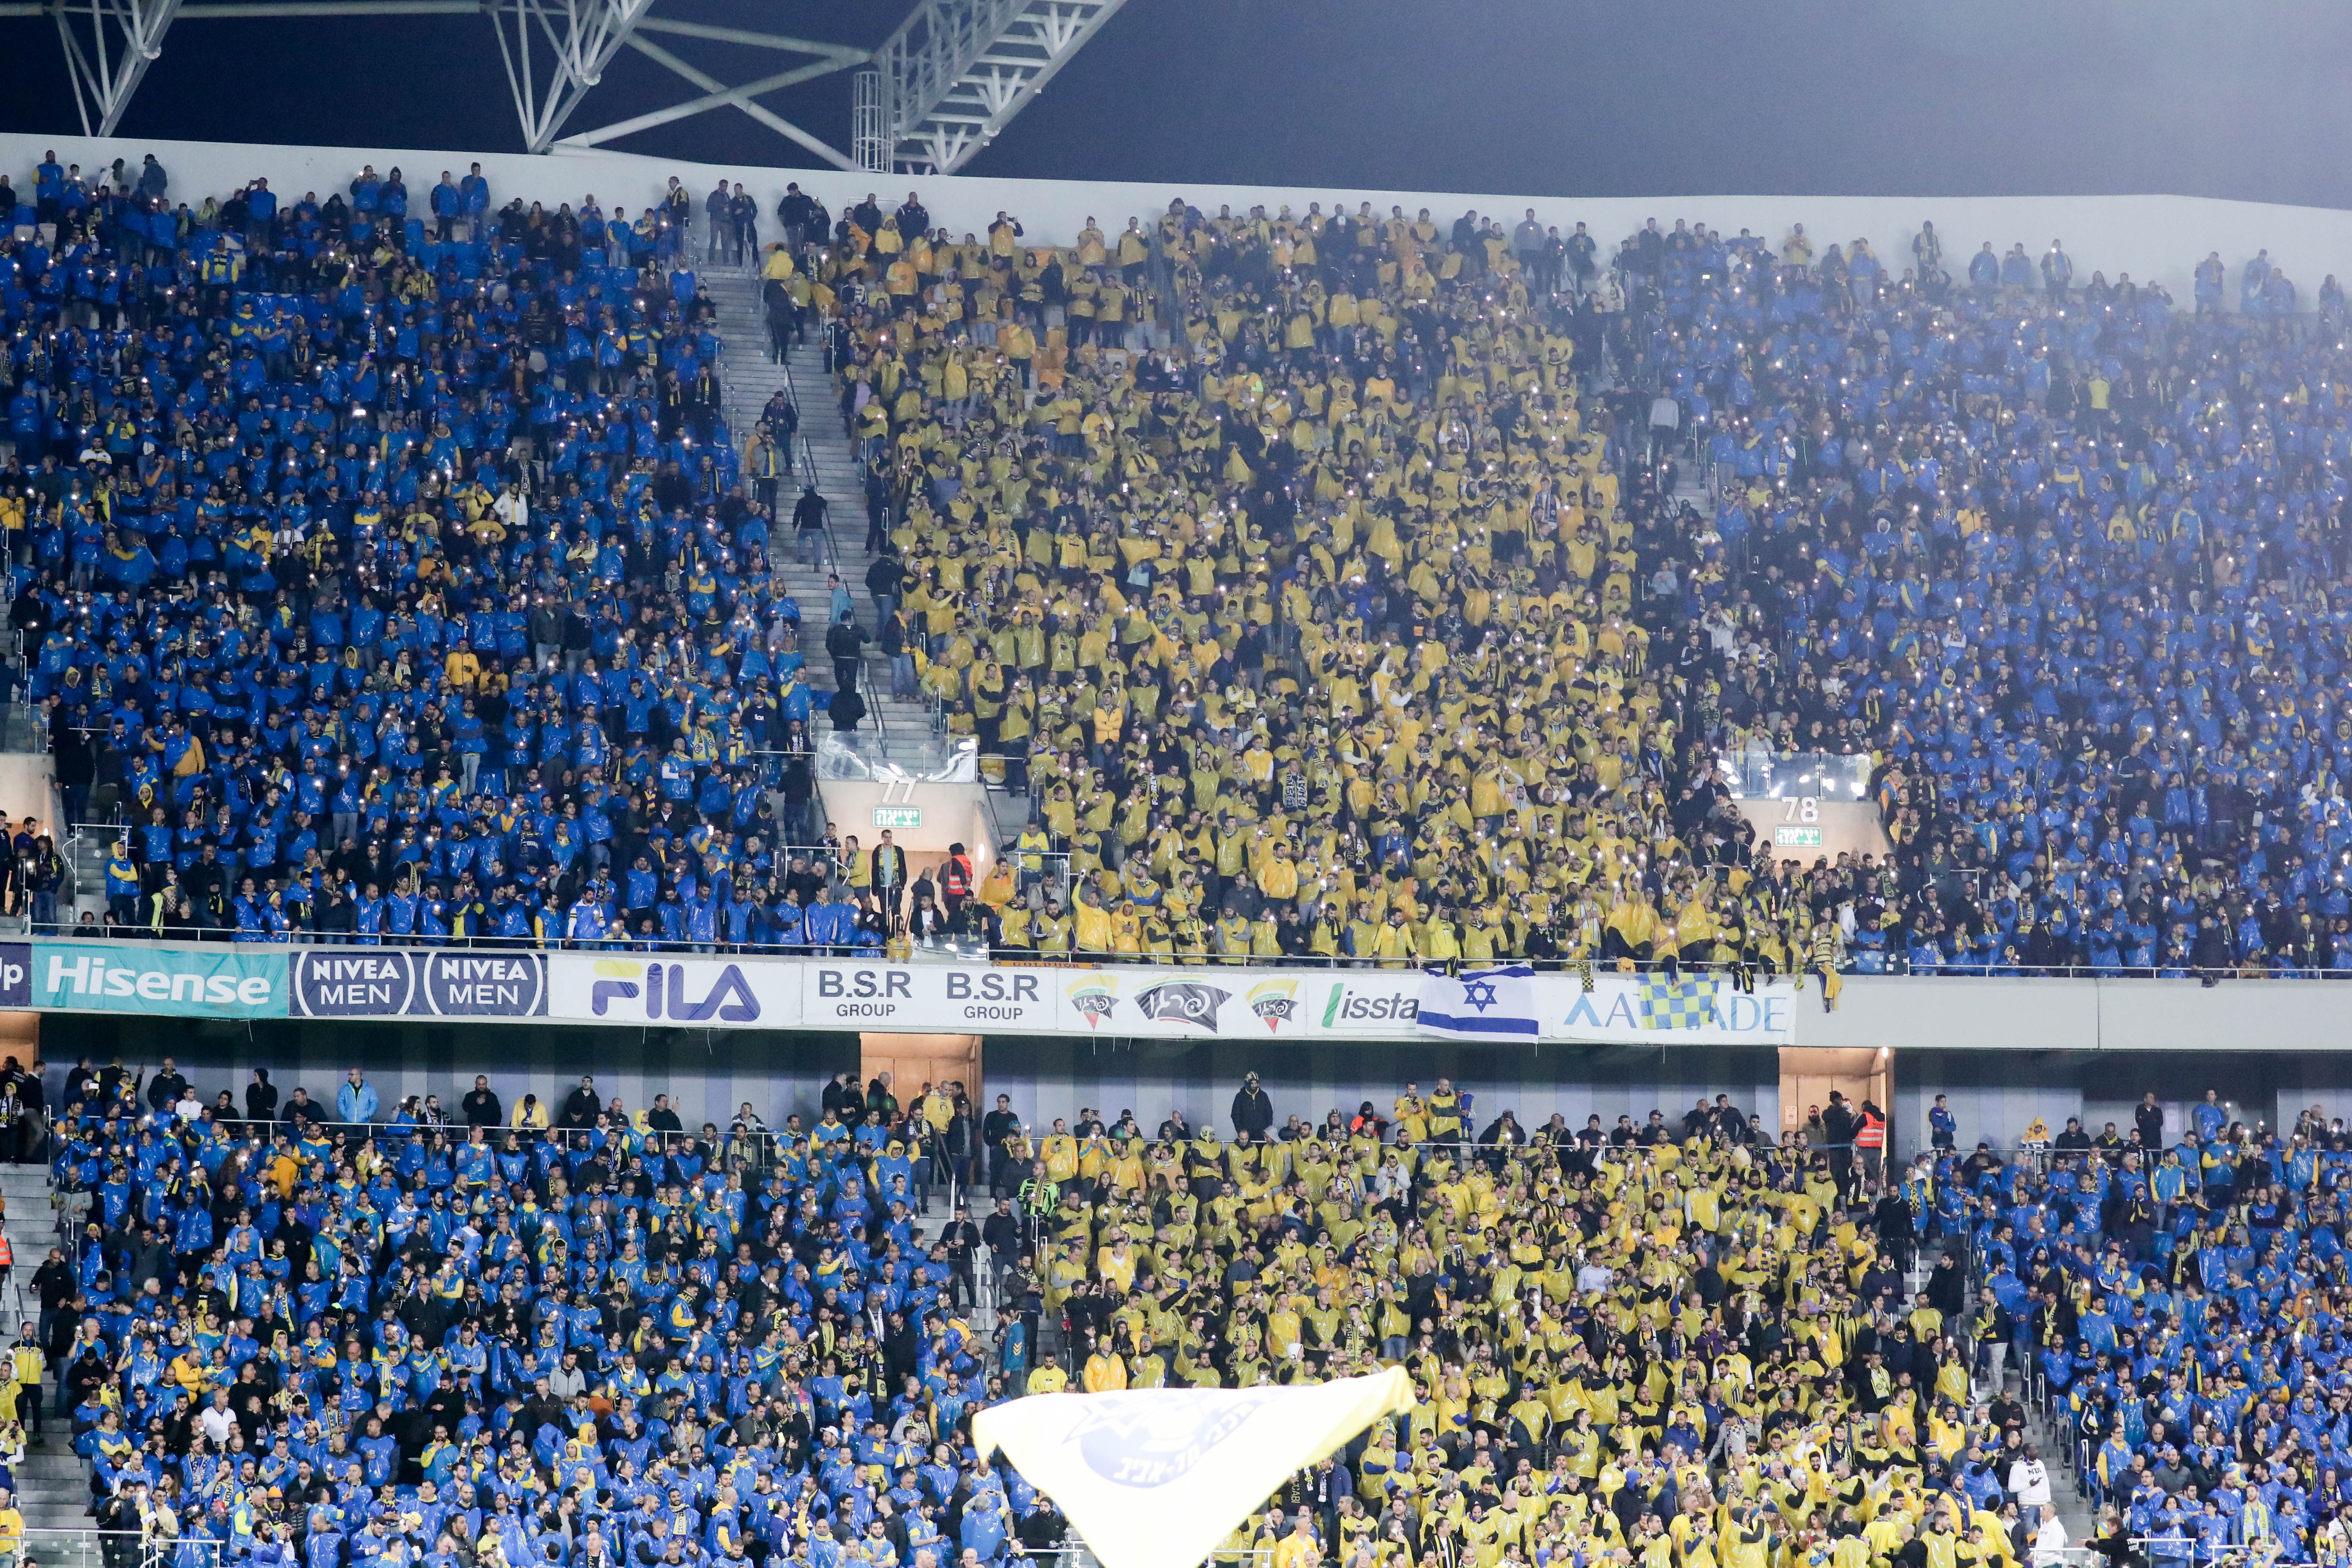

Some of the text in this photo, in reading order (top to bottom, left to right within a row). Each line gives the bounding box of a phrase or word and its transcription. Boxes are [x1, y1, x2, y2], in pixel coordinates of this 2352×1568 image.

[879, 777, 916, 803] 77
[876, 809, 917, 825] יציאה
[1782, 797, 1818, 822] 78
[1777, 829, 1818, 844] יציאה
[47, 955, 270, 1004] Hisense
[313, 959, 400, 980] NIVEA
[442, 959, 528, 981] NIVEA
[321, 984, 389, 1004] MEN
[450, 984, 518, 1004] MEN
[592, 960, 760, 1021] FILA
[819, 971, 912, 998] B.S.R
[947, 973, 1039, 1002] B.S.R
[836, 1004, 895, 1017] GROUP
[964, 1006, 1023, 1020] GROUP
[1079, 997, 1109, 1011] פרגו
[1150, 989, 1210, 1018] פרגו
[1259, 1001, 1288, 1016] פרגו
[1341, 991, 1419, 1019] issta
